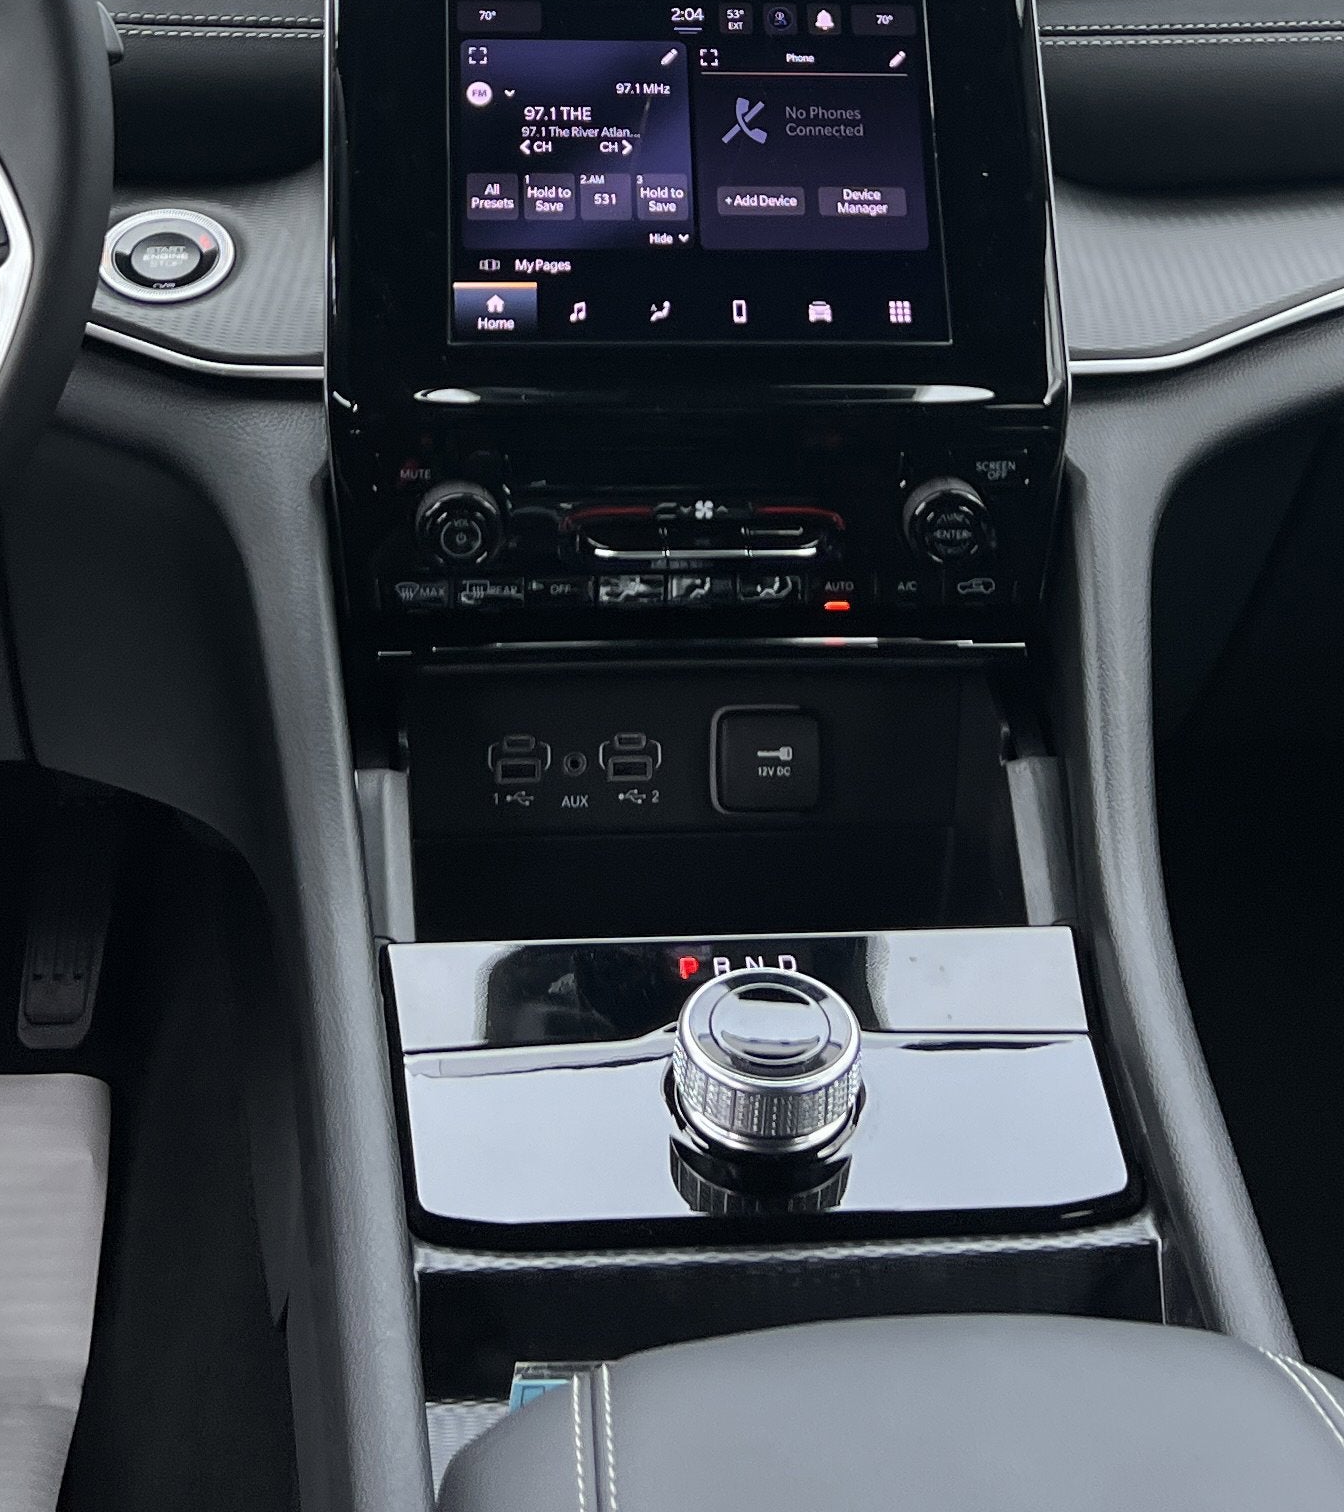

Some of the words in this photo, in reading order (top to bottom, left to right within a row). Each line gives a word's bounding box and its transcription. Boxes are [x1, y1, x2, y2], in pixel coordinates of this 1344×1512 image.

[478, 10, 497, 21] 70°
[671, 7, 705, 21] 2:04
[876, 14, 894, 25] 70°
[728, 21, 743, 30] EXT
[786, 53, 815, 64] Phone
[472, 89, 487, 98] FM
[616, 83, 640, 95] 97.1
[643, 83, 670, 94] MHz
[524, 106, 556, 121] 97.1
[560, 106, 592, 121] THE
[785, 106, 806, 119] No
[810, 106, 861, 120] Phones
[521, 127, 546, 138] 97.1
[549, 126, 570, 138] The
[571, 126, 599, 138] River
[786, 123, 864, 137] Connected
[533, 141, 552, 153] CH
[600, 141, 618, 153] CH
[525, 175, 530, 185] 1
[636, 175, 643, 185] 3
[484, 183, 500, 195] All
[527, 187, 556, 199] Hold
[558, 187, 572, 199] to
[640, 187, 669, 199] Hold
[671, 187, 684, 199] to
[843, 189, 882, 201] Device
[471, 198, 515, 209] Presets
[594, 194, 617, 205] 531
[734, 195, 758, 207] Add
[760, 195, 798, 207] Device
[535, 200, 564, 212] Save
[648, 200, 677, 212] Save
[837, 202, 889, 216] Manager
[649, 233, 674, 245] Hide
[147, 245, 186, 254] START
[515, 259, 535, 274] My
[536, 259, 572, 274] Pages
[477, 317, 515, 331] Home
[976, 461, 1016, 472] SCREEN
[400, 469, 431, 480] MUTE
[987, 470, 1007, 481] OFF
[420, 587, 445, 598] MAX
[825, 581, 854, 592] AUTO
[897, 581, 917, 592] A/C
[758, 766, 775, 777] 12V
[777, 766, 791, 776] DC
[494, 793, 499, 804] 1
[561, 795, 589, 808] AUX
[652, 790, 660, 803] 2
[679, 956, 699, 979] P
[713, 957, 731, 977] R
[745, 956, 764, 969] N
[778, 954, 798, 973] D
